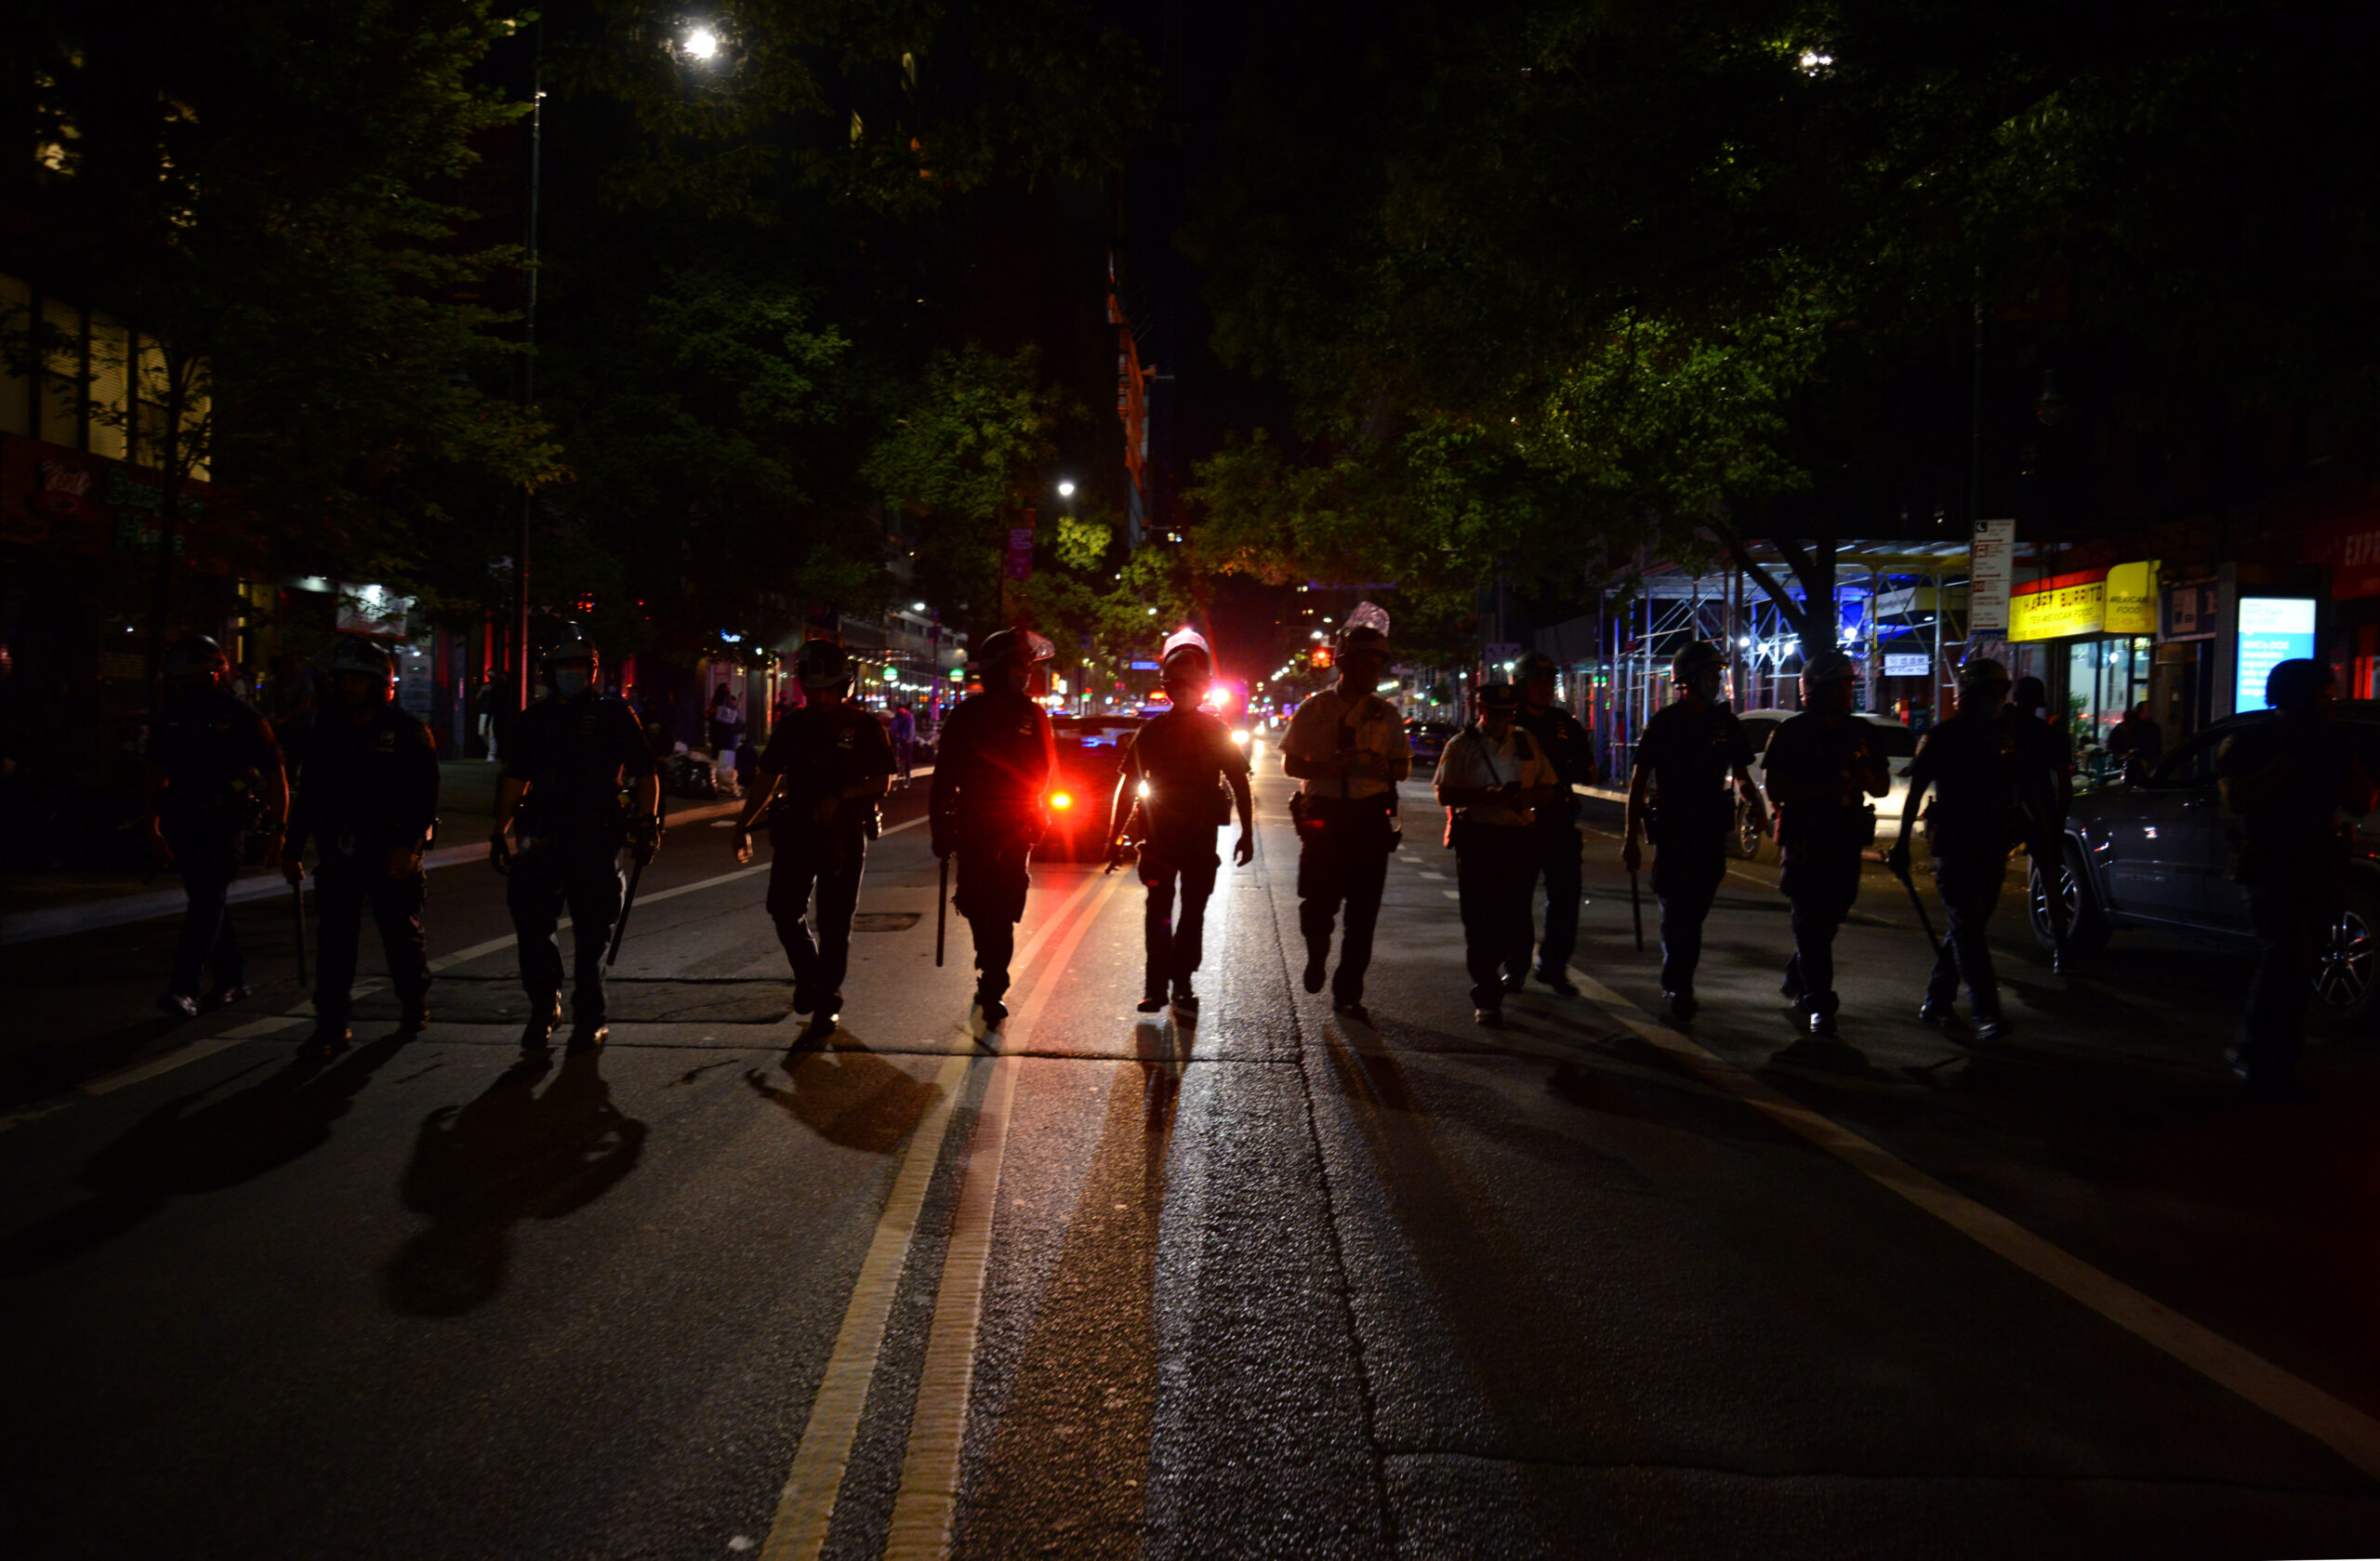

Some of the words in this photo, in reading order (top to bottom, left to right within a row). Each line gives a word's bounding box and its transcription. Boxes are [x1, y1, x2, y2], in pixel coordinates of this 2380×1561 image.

[2023, 594, 2053, 613] HAPPY
[2061, 586, 2102, 607] BURRITO
[2109, 596, 2149, 604] MEXICAN
[2074, 607, 2095, 617] FOOD
[2242, 641, 2268, 650] NYC's
[2269, 641, 2291, 650] DOE
